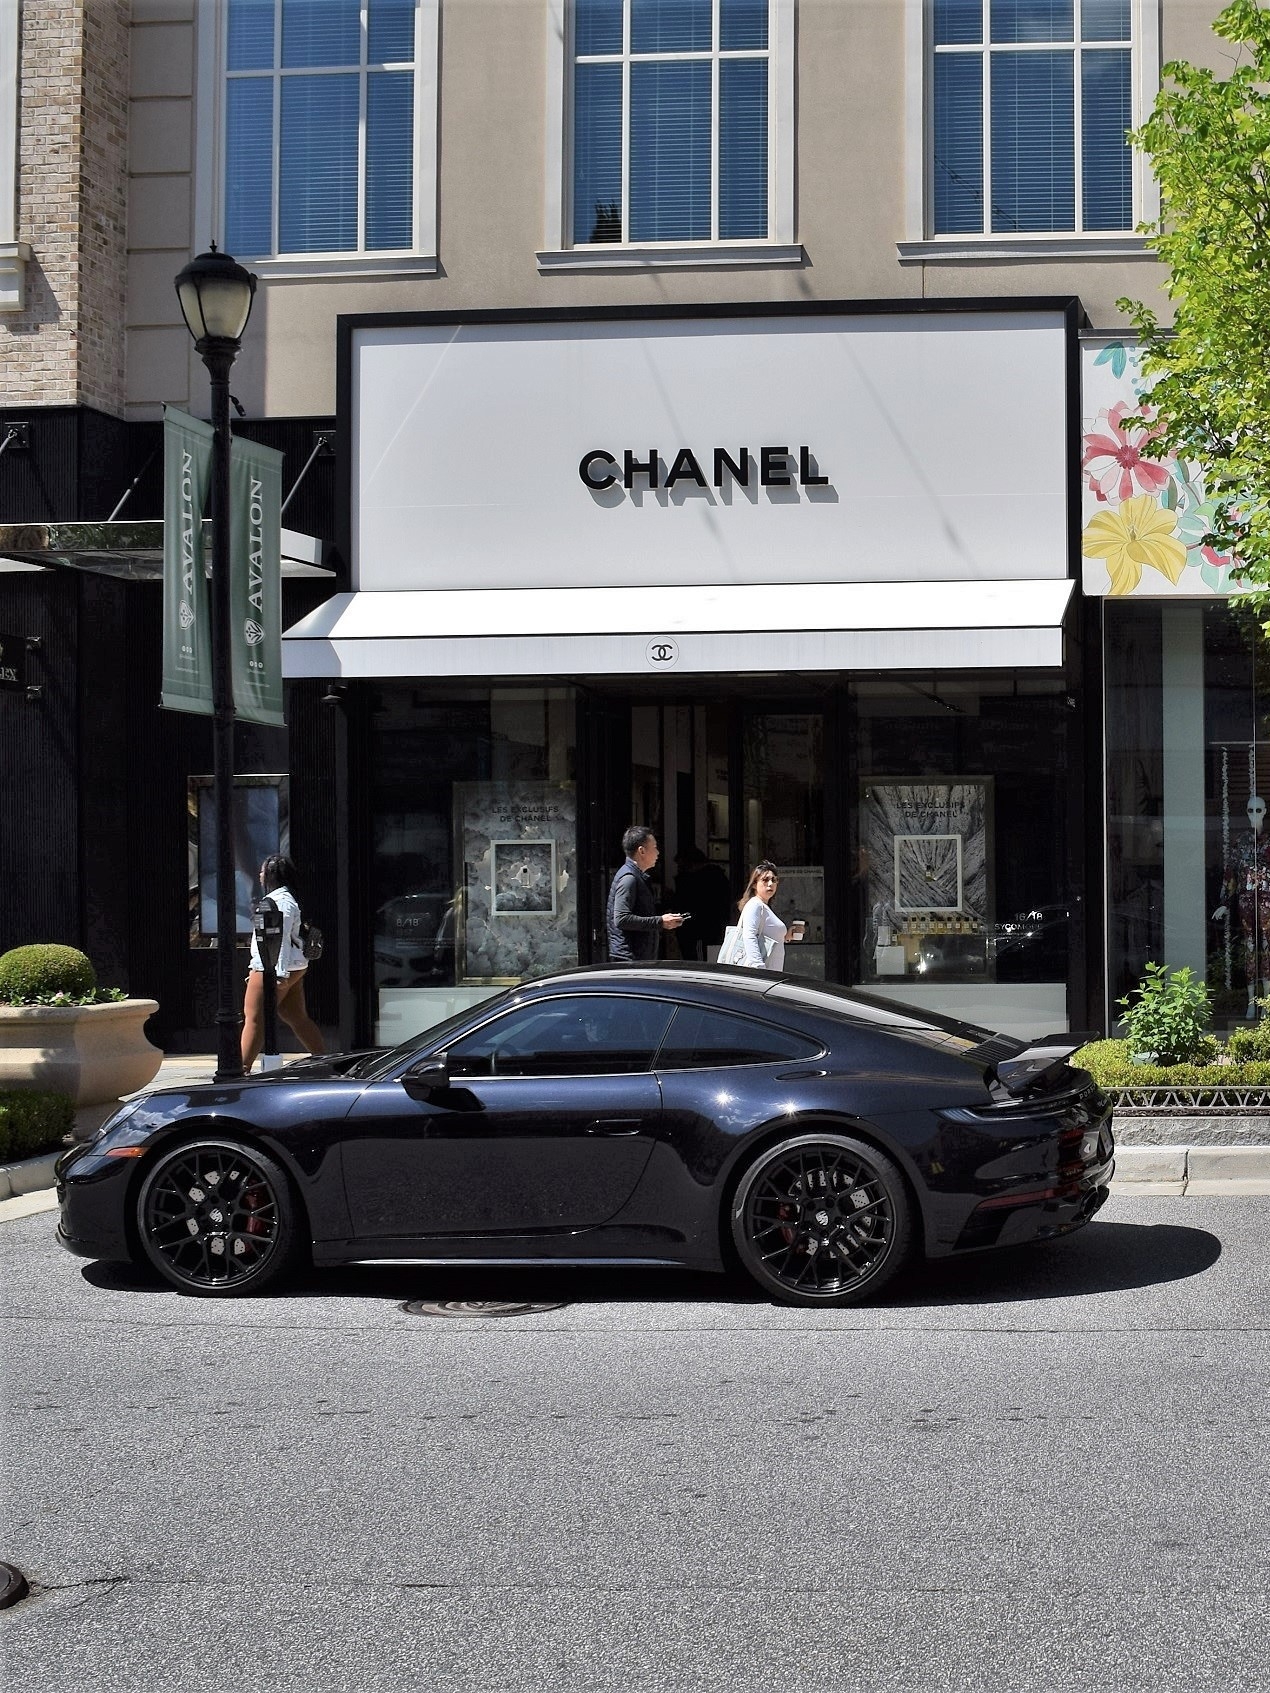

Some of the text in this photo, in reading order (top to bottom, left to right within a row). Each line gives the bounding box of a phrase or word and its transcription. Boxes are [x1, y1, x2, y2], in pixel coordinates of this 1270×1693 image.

[578, 446, 829, 490] CHANEL
[181, 448, 194, 595] AVALON
[248, 475, 264, 613] AVALON
[510, 805, 559, 813] EXCLUSIFS
[917, 801, 965, 809] EXCLUSIFS
